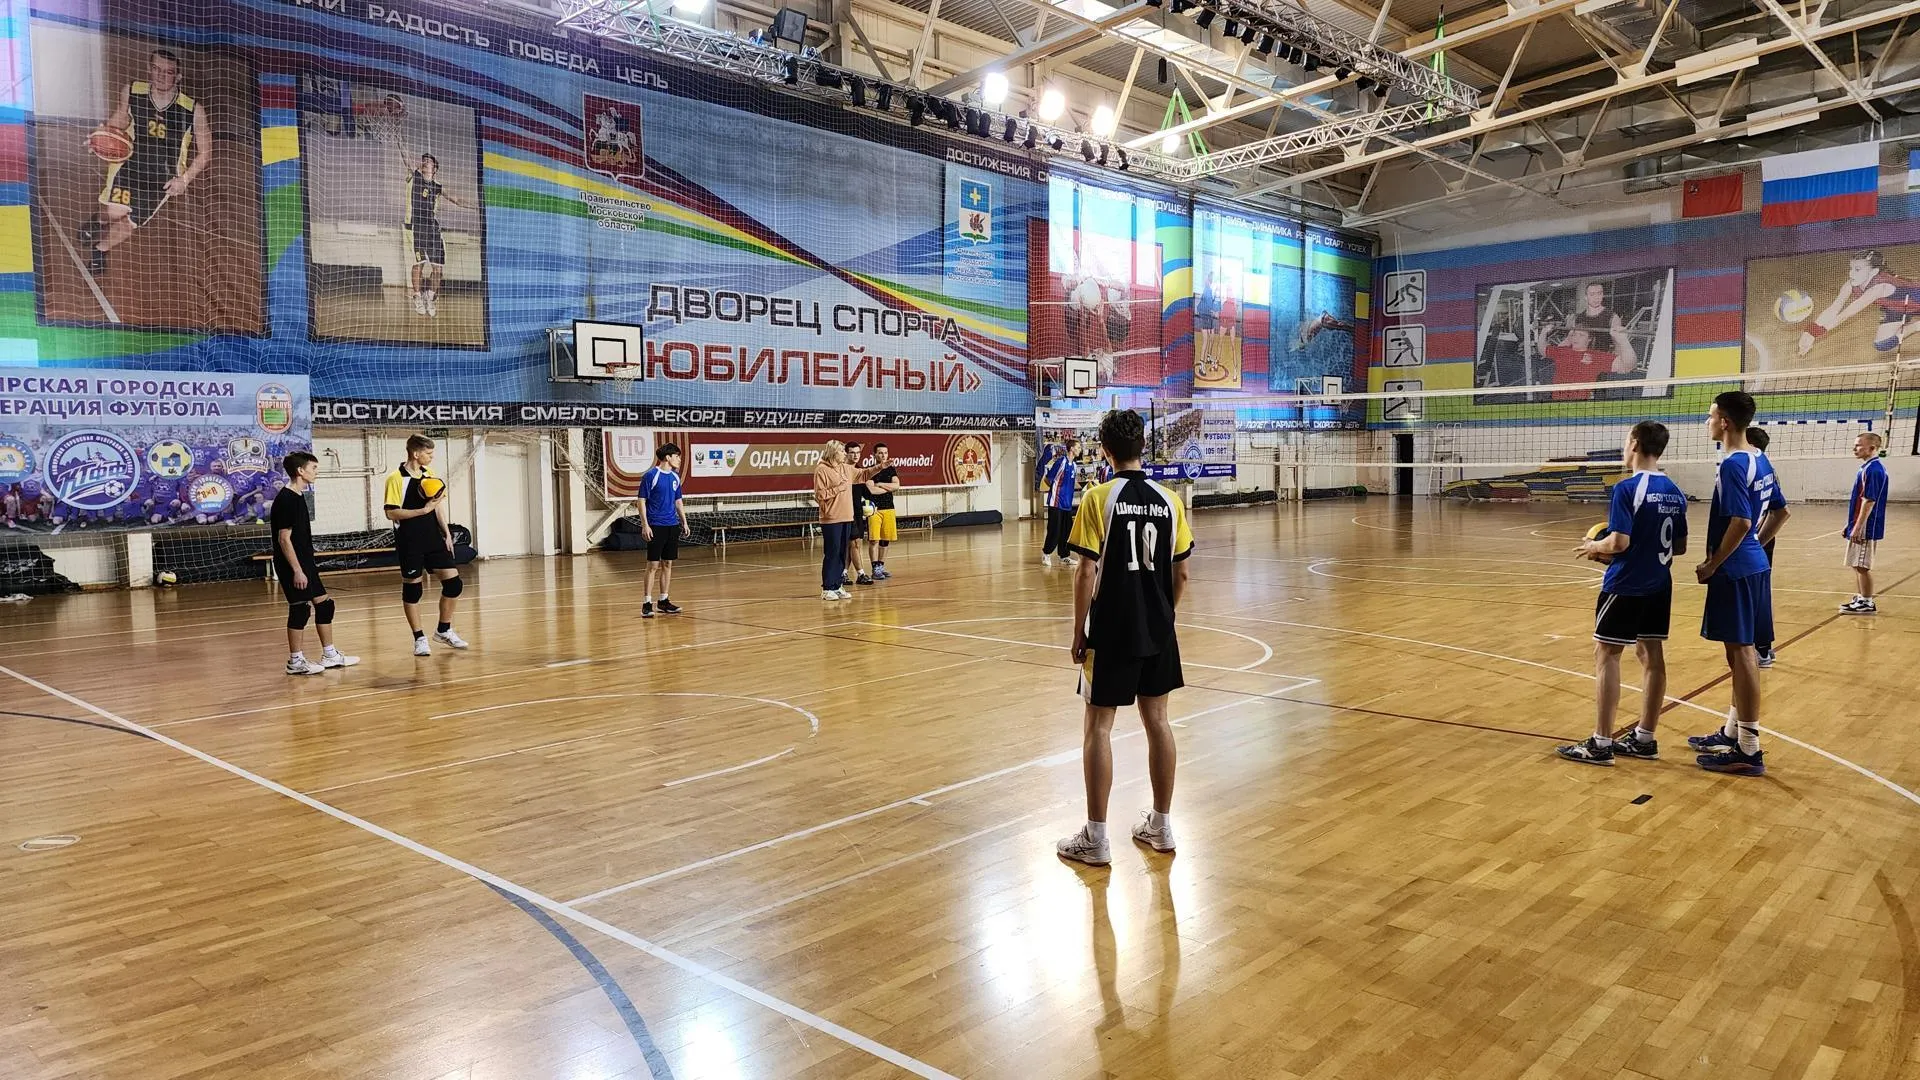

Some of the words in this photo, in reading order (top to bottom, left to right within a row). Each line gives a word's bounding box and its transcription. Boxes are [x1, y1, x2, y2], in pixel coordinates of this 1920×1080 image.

[368, 4, 490, 47] РАДОСТЬ
[508, 38, 600, 73] ПОБЕДА
[616, 65, 669, 89] ЦЕЛЬ
[148, 120, 167, 139] 26
[946, 147, 1030, 178] ДОСТИЖЕНИЯ
[580, 191, 652, 211] Правительство
[588, 205, 645, 222] Московской
[597, 220, 637, 232] области
[1324, 236, 1344, 249] СТАРТ
[647, 283, 822, 336] ДВОРЕЦ
[832, 303, 964, 344] СПОРТА
[0, 377, 88, 394] РСКАЯ
[96, 379, 235, 399] ГОРОДСКАЯ
[109, 400, 222, 417] ФУТБОЛА
[311, 402, 504, 422] ДОСТИЖЕНИЯ
[520, 406, 639, 421] СМЕЛОСТЬ
[652, 408, 726, 425] РЕКОРД
[743, 411, 825, 426] БУДУЩЕЕ
[838, 413, 886, 424] СПОРТ
[894, 414, 932, 426] СИЛА
[940, 415, 1009, 427] ДИНАМИКА
[749, 450, 791, 469] ОДНА
[1115, 501, 1148, 516] Школа
[1149, 503, 1169, 519] №4
[1126, 520, 1158, 572] 10
[1657, 516, 1673, 566] 9
